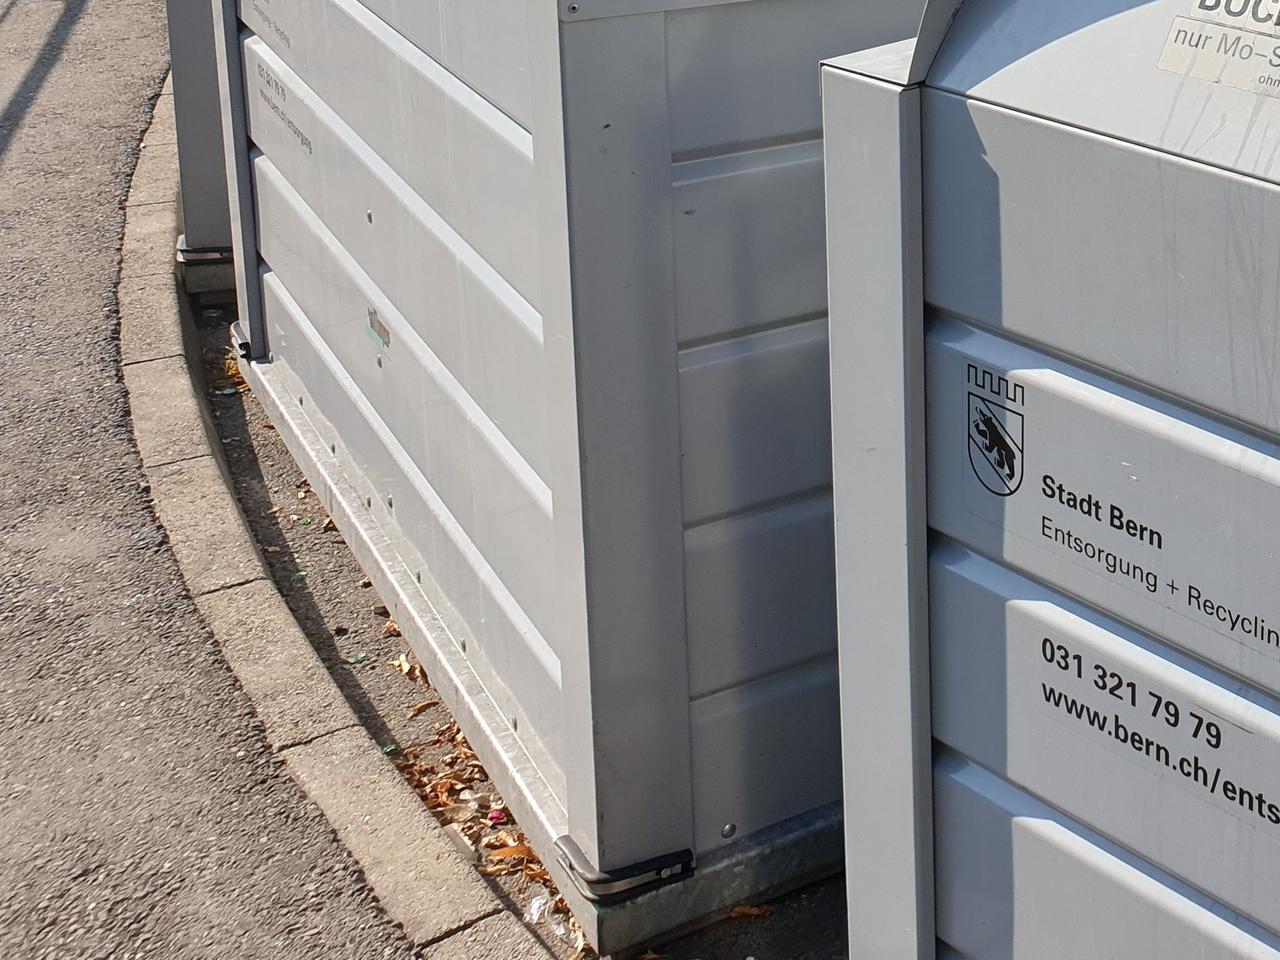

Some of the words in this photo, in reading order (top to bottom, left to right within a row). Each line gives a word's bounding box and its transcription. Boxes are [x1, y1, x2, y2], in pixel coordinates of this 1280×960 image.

[1173, 26, 1209, 52] nur
[1041, 473, 1102, 522] Stadt
[1109, 503, 1163, 550] Bern
[1041, 515, 1158, 594] Entsorgung
[1165, 579, 1179, 596] +
[1041, 636, 1083, 680] 031
[1093, 664, 1138, 708] 321
[1148, 691, 1180, 728] 79
[1189, 711, 1222, 749] 79
